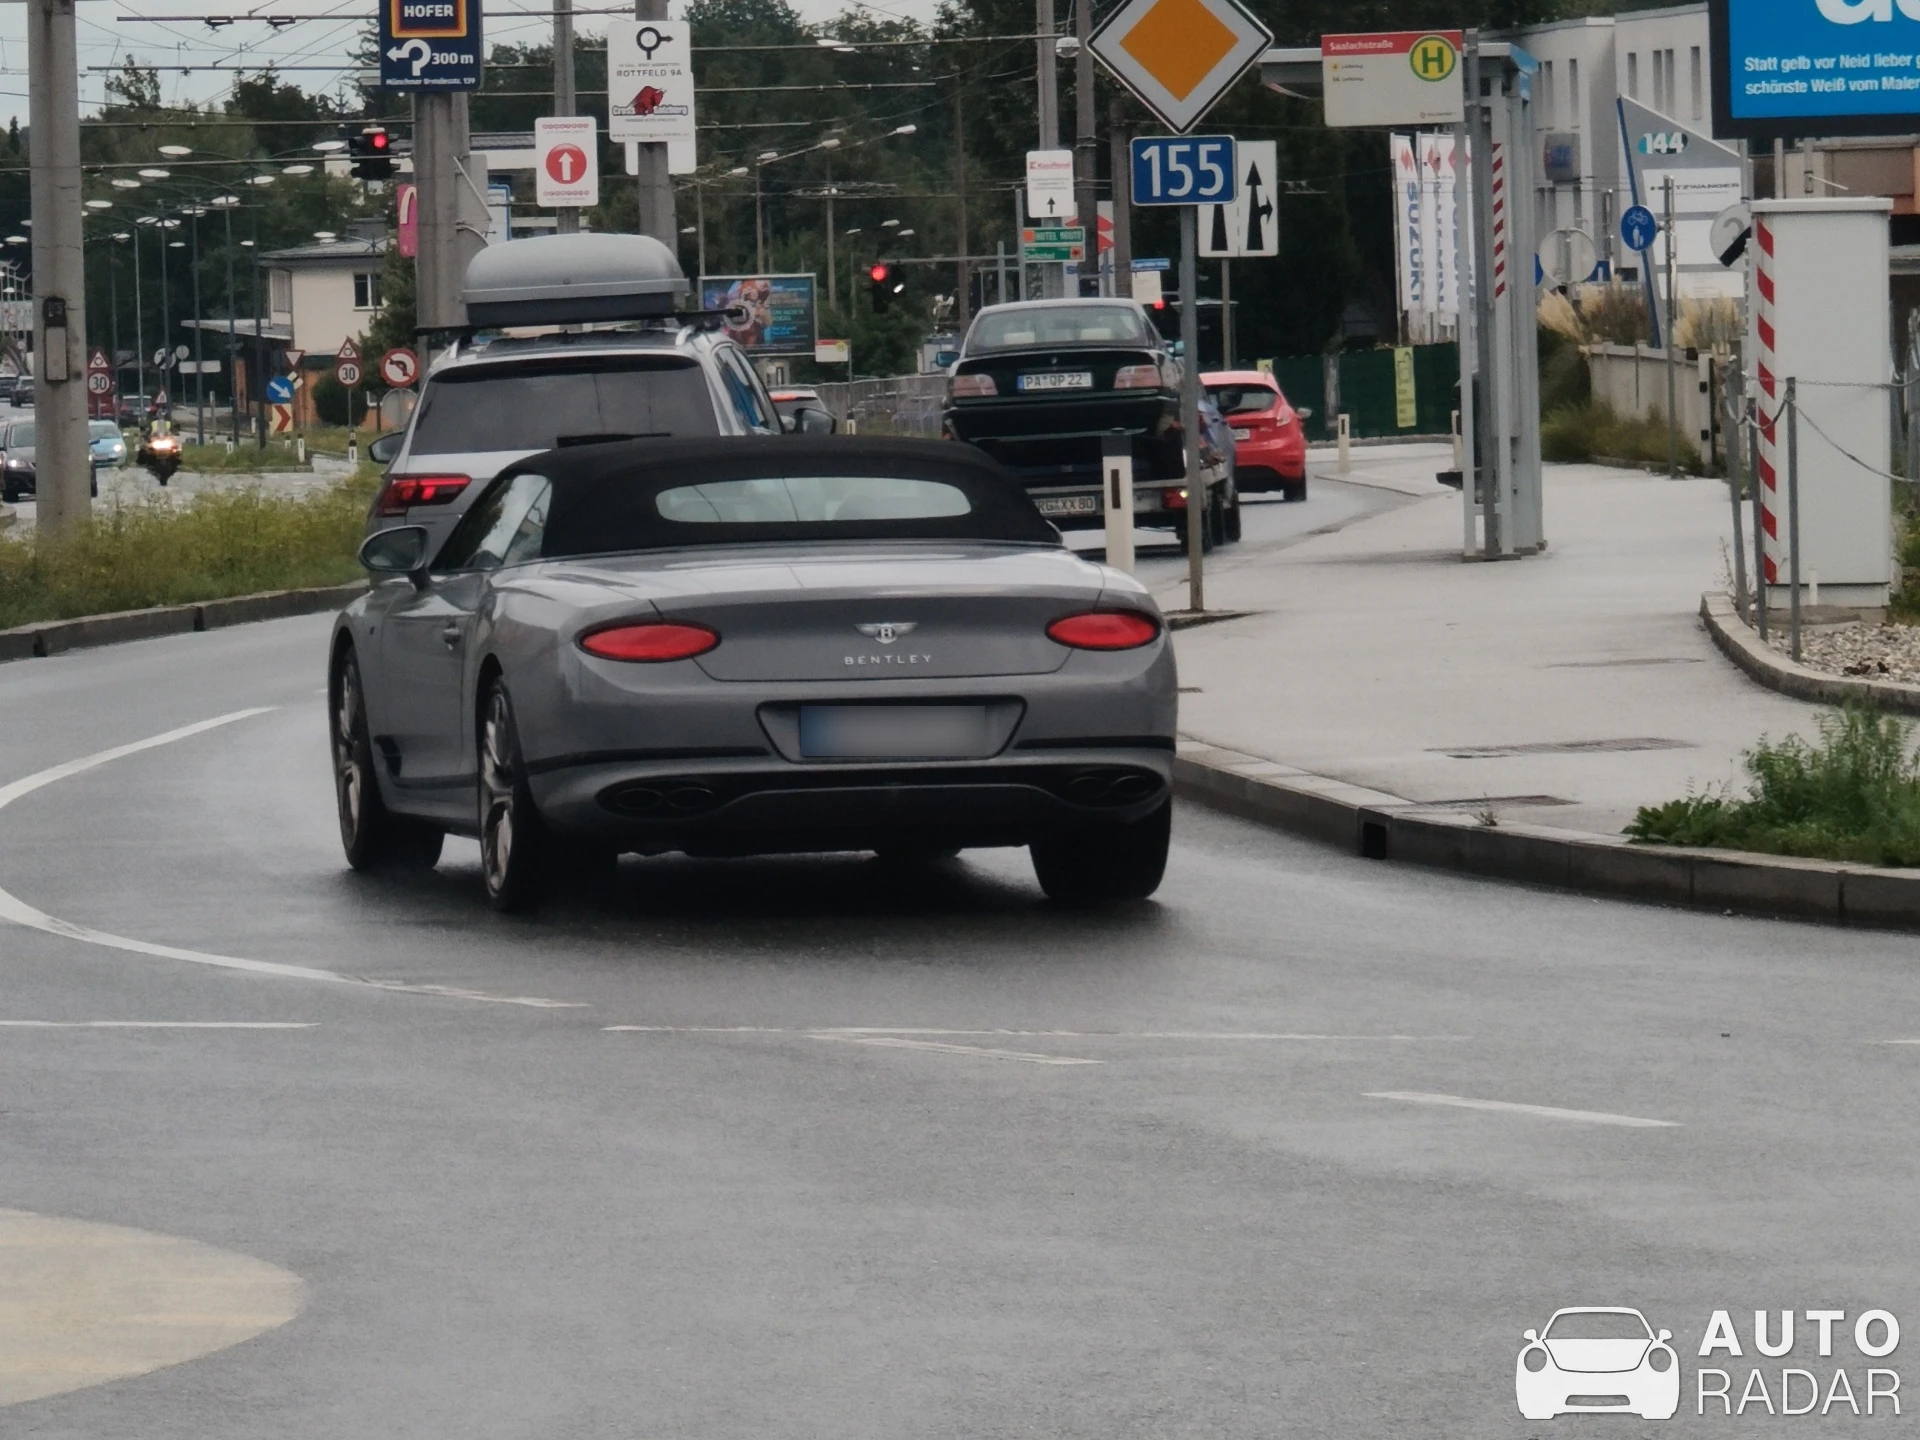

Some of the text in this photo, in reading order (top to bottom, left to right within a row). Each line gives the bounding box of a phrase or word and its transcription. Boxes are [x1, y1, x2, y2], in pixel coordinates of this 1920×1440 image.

[404, 5, 454, 18] HOFER
[431, 53, 474, 65] 300 m
[1421, 46, 1444, 74] H
[1744, 56, 1778, 72] Statt
[1781, 56, 1811, 74] gelb
[1814, 58, 1836, 70] vor
[1839, 54, 1870, 69] Neid
[1874, 53, 1912, 68] lieber
[616, 69, 682, 78] ROTTFELD 9A
[1745, 79, 1808, 95] schönste
[1811, 77, 1846, 93] Weiß
[1849, 78, 1878, 92] vom
[1643, 131, 1685, 155] 144
[1140, 143, 1224, 197] 155
[1406, 180, 1420, 302] SUZUKI
[342, 367, 356, 381] 30
[1026, 376, 1042, 387] PA
[1068, 374, 1083, 386] 22
[91, 376, 107, 391] 30
[844, 654, 932, 666] BENTLEY
